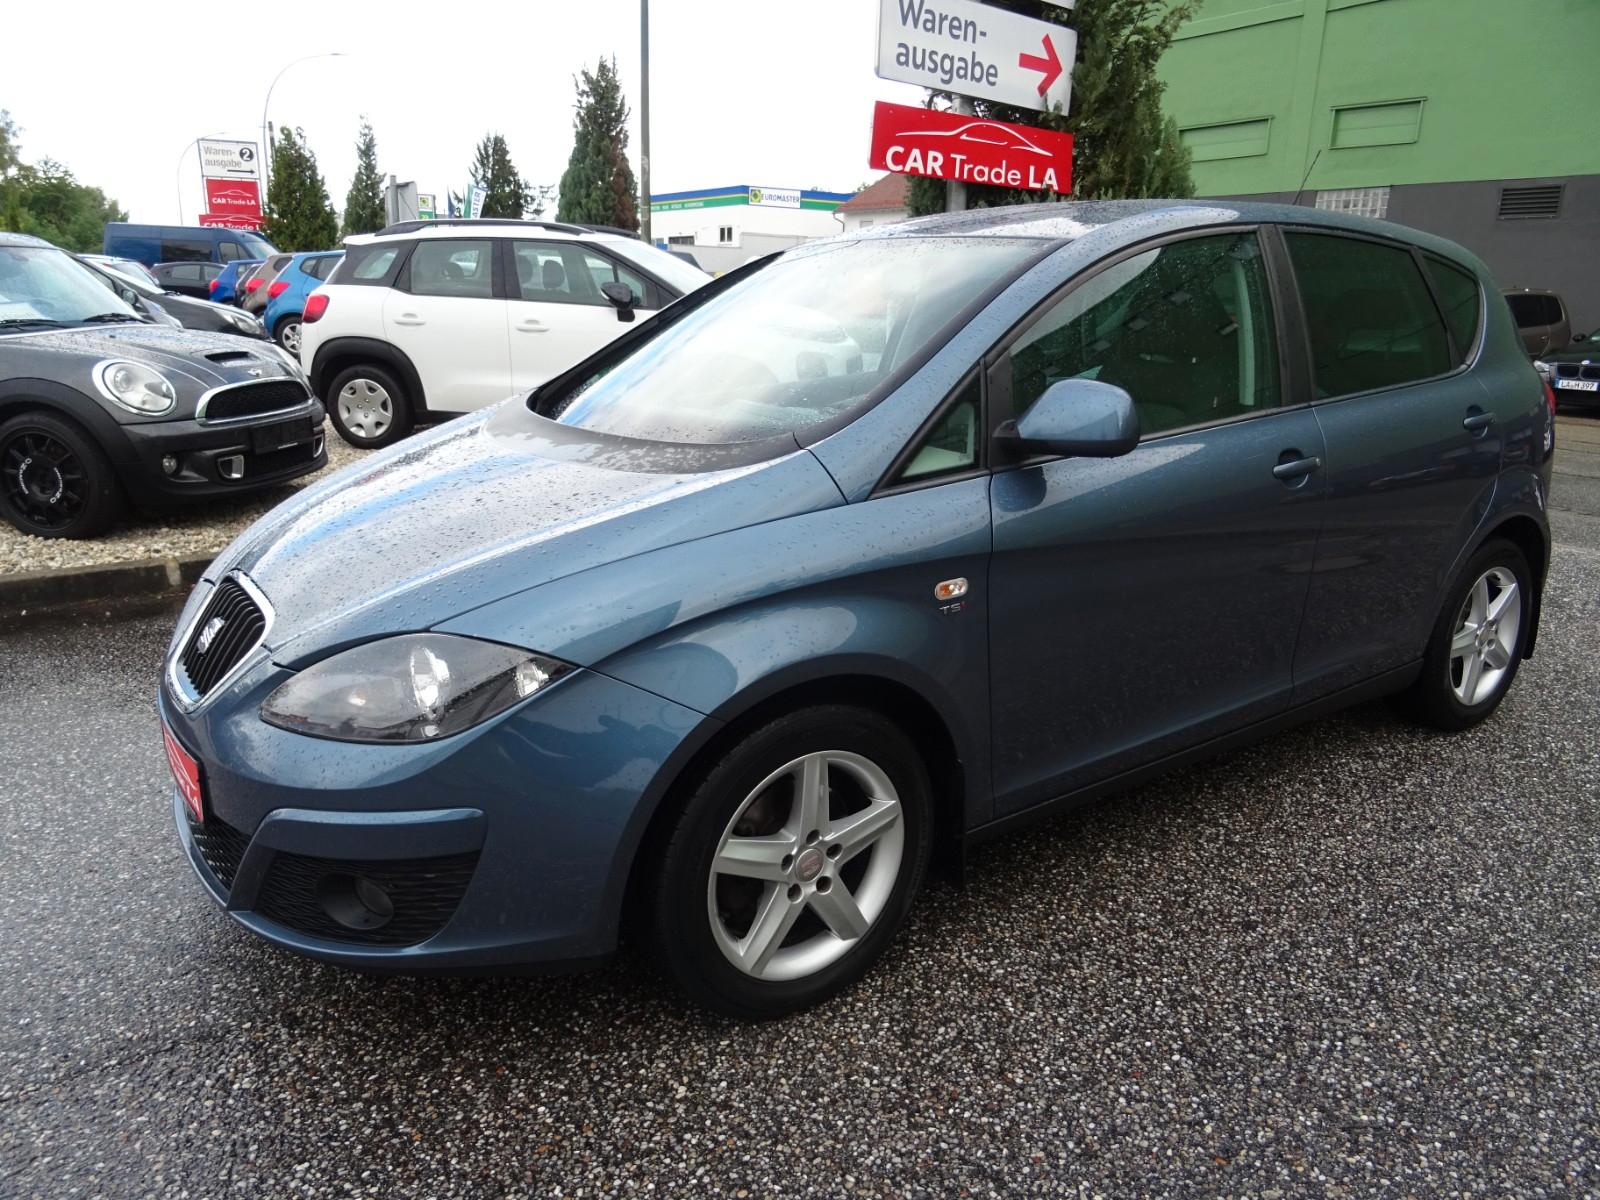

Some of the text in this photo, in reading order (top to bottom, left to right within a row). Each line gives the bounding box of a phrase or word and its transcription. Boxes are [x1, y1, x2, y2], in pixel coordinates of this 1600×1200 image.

[898, 0, 987, 44] Waren-
[896, 42, 998, 86] ausgabe
[203, 145, 236, 156] Waren-
[242, 148, 251, 161] 2
[204, 159, 242, 168] ausgabe
[885, 146, 1059, 190] CAR Trade LA
[761, 193, 800, 204] EUROMASTER
